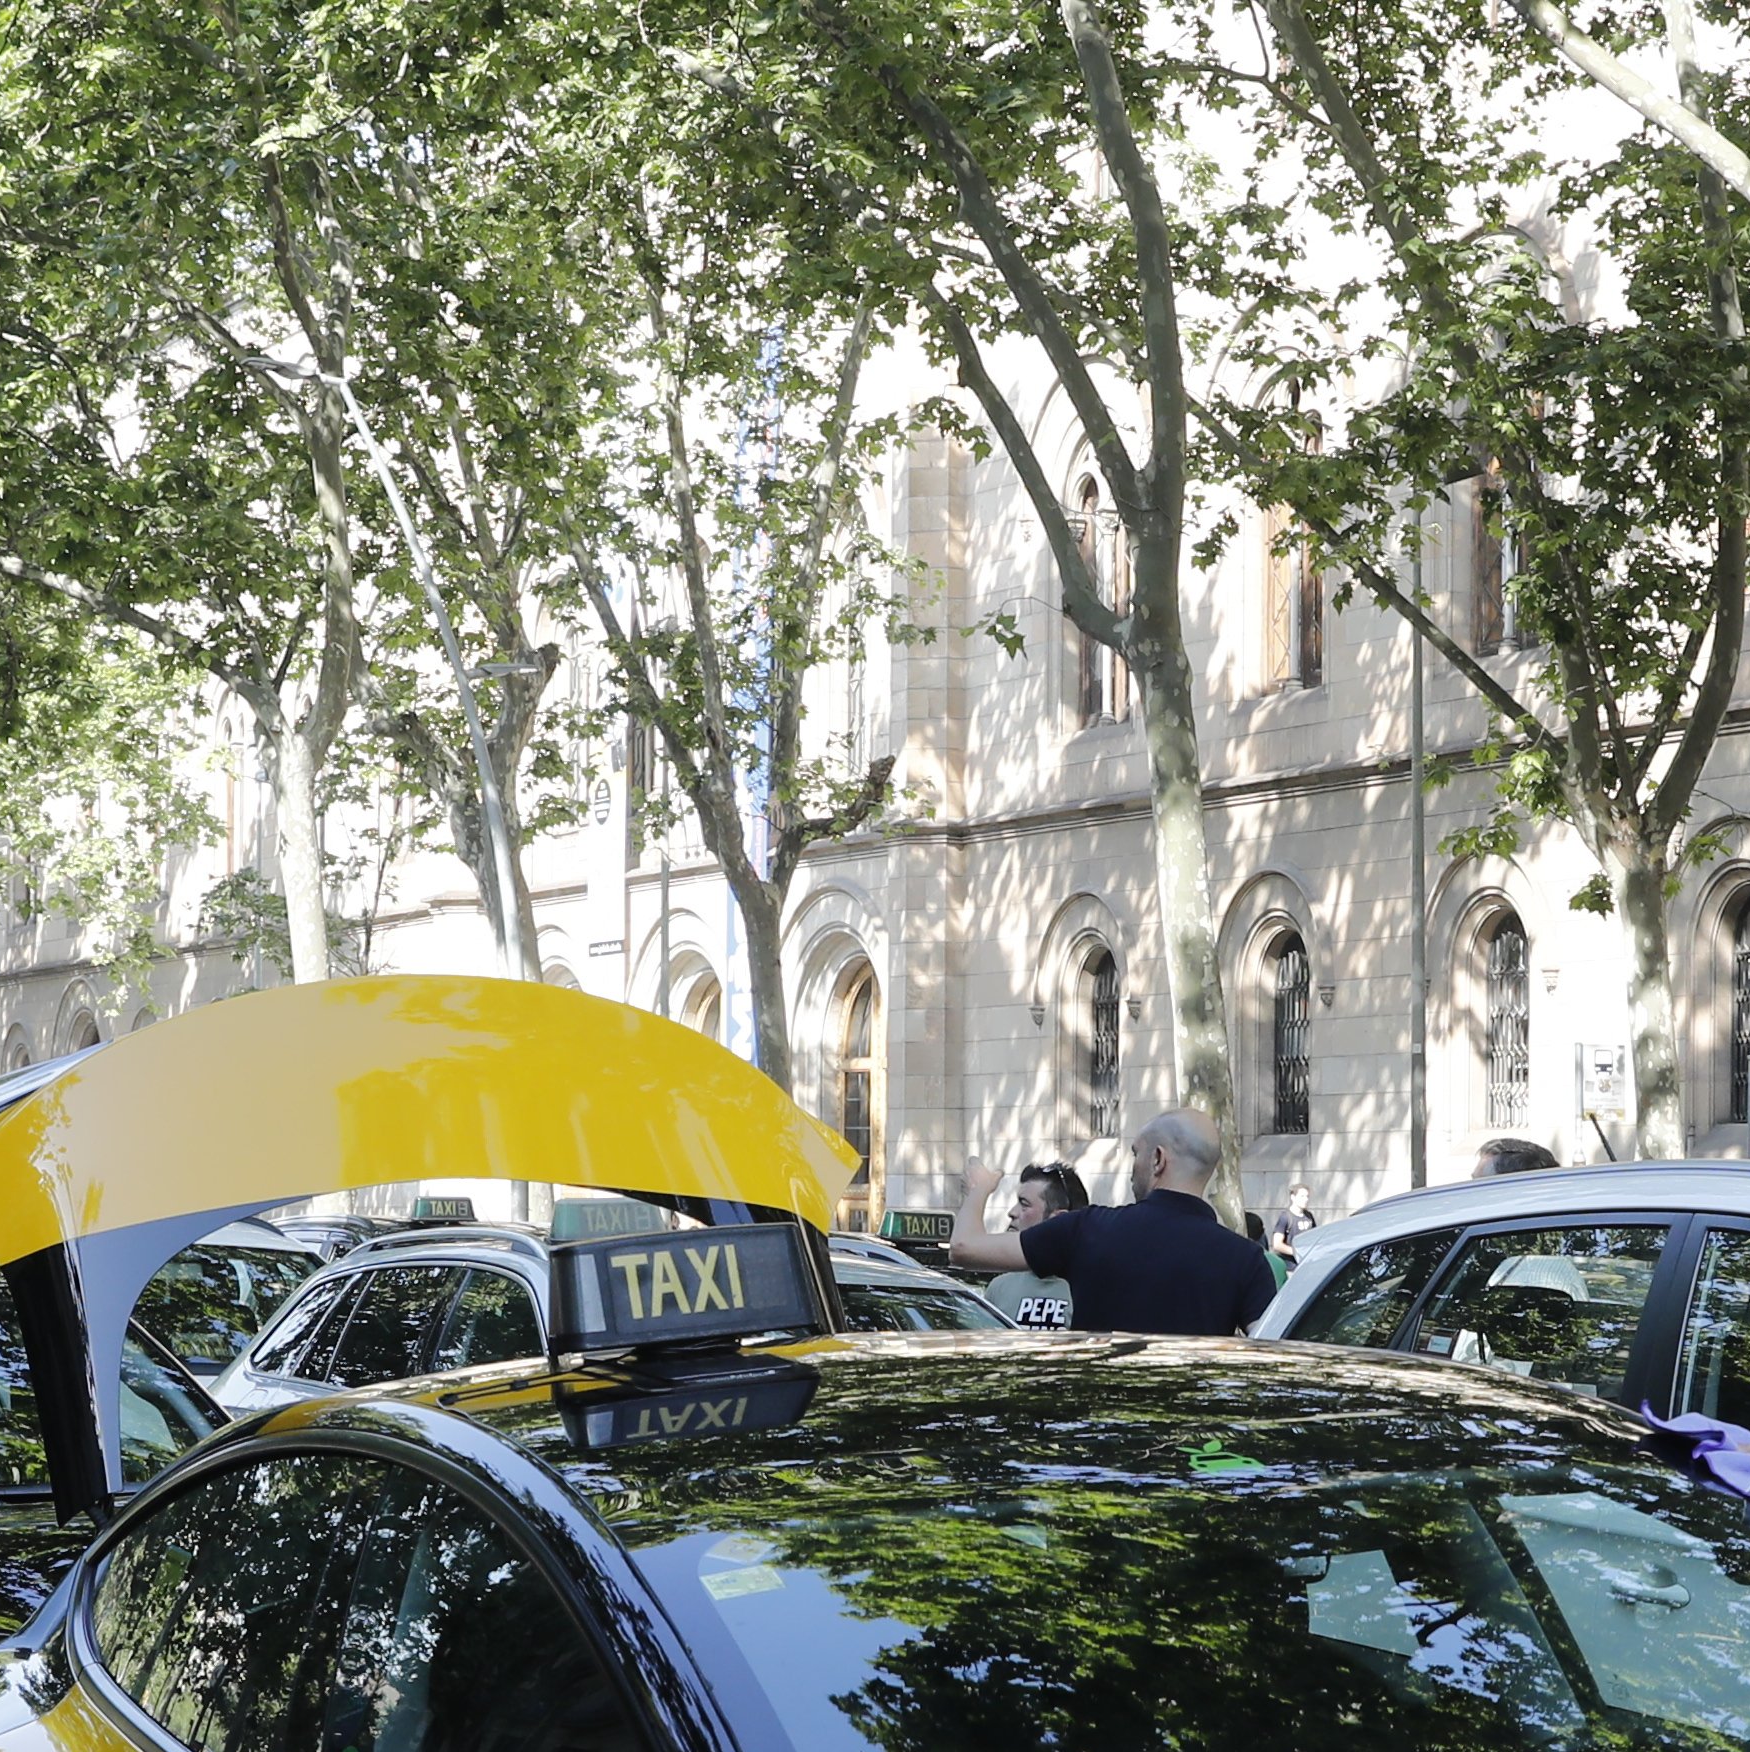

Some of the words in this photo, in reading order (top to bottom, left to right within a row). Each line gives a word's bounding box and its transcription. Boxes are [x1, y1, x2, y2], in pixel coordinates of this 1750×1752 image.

[429, 1200, 458, 1218] TAXI
[583, 1206, 631, 1233] TAXI
[904, 1215, 934, 1236] TAXI
[610, 1244, 745, 1320] TAXI
[1016, 1297, 1069, 1324] PEPE
